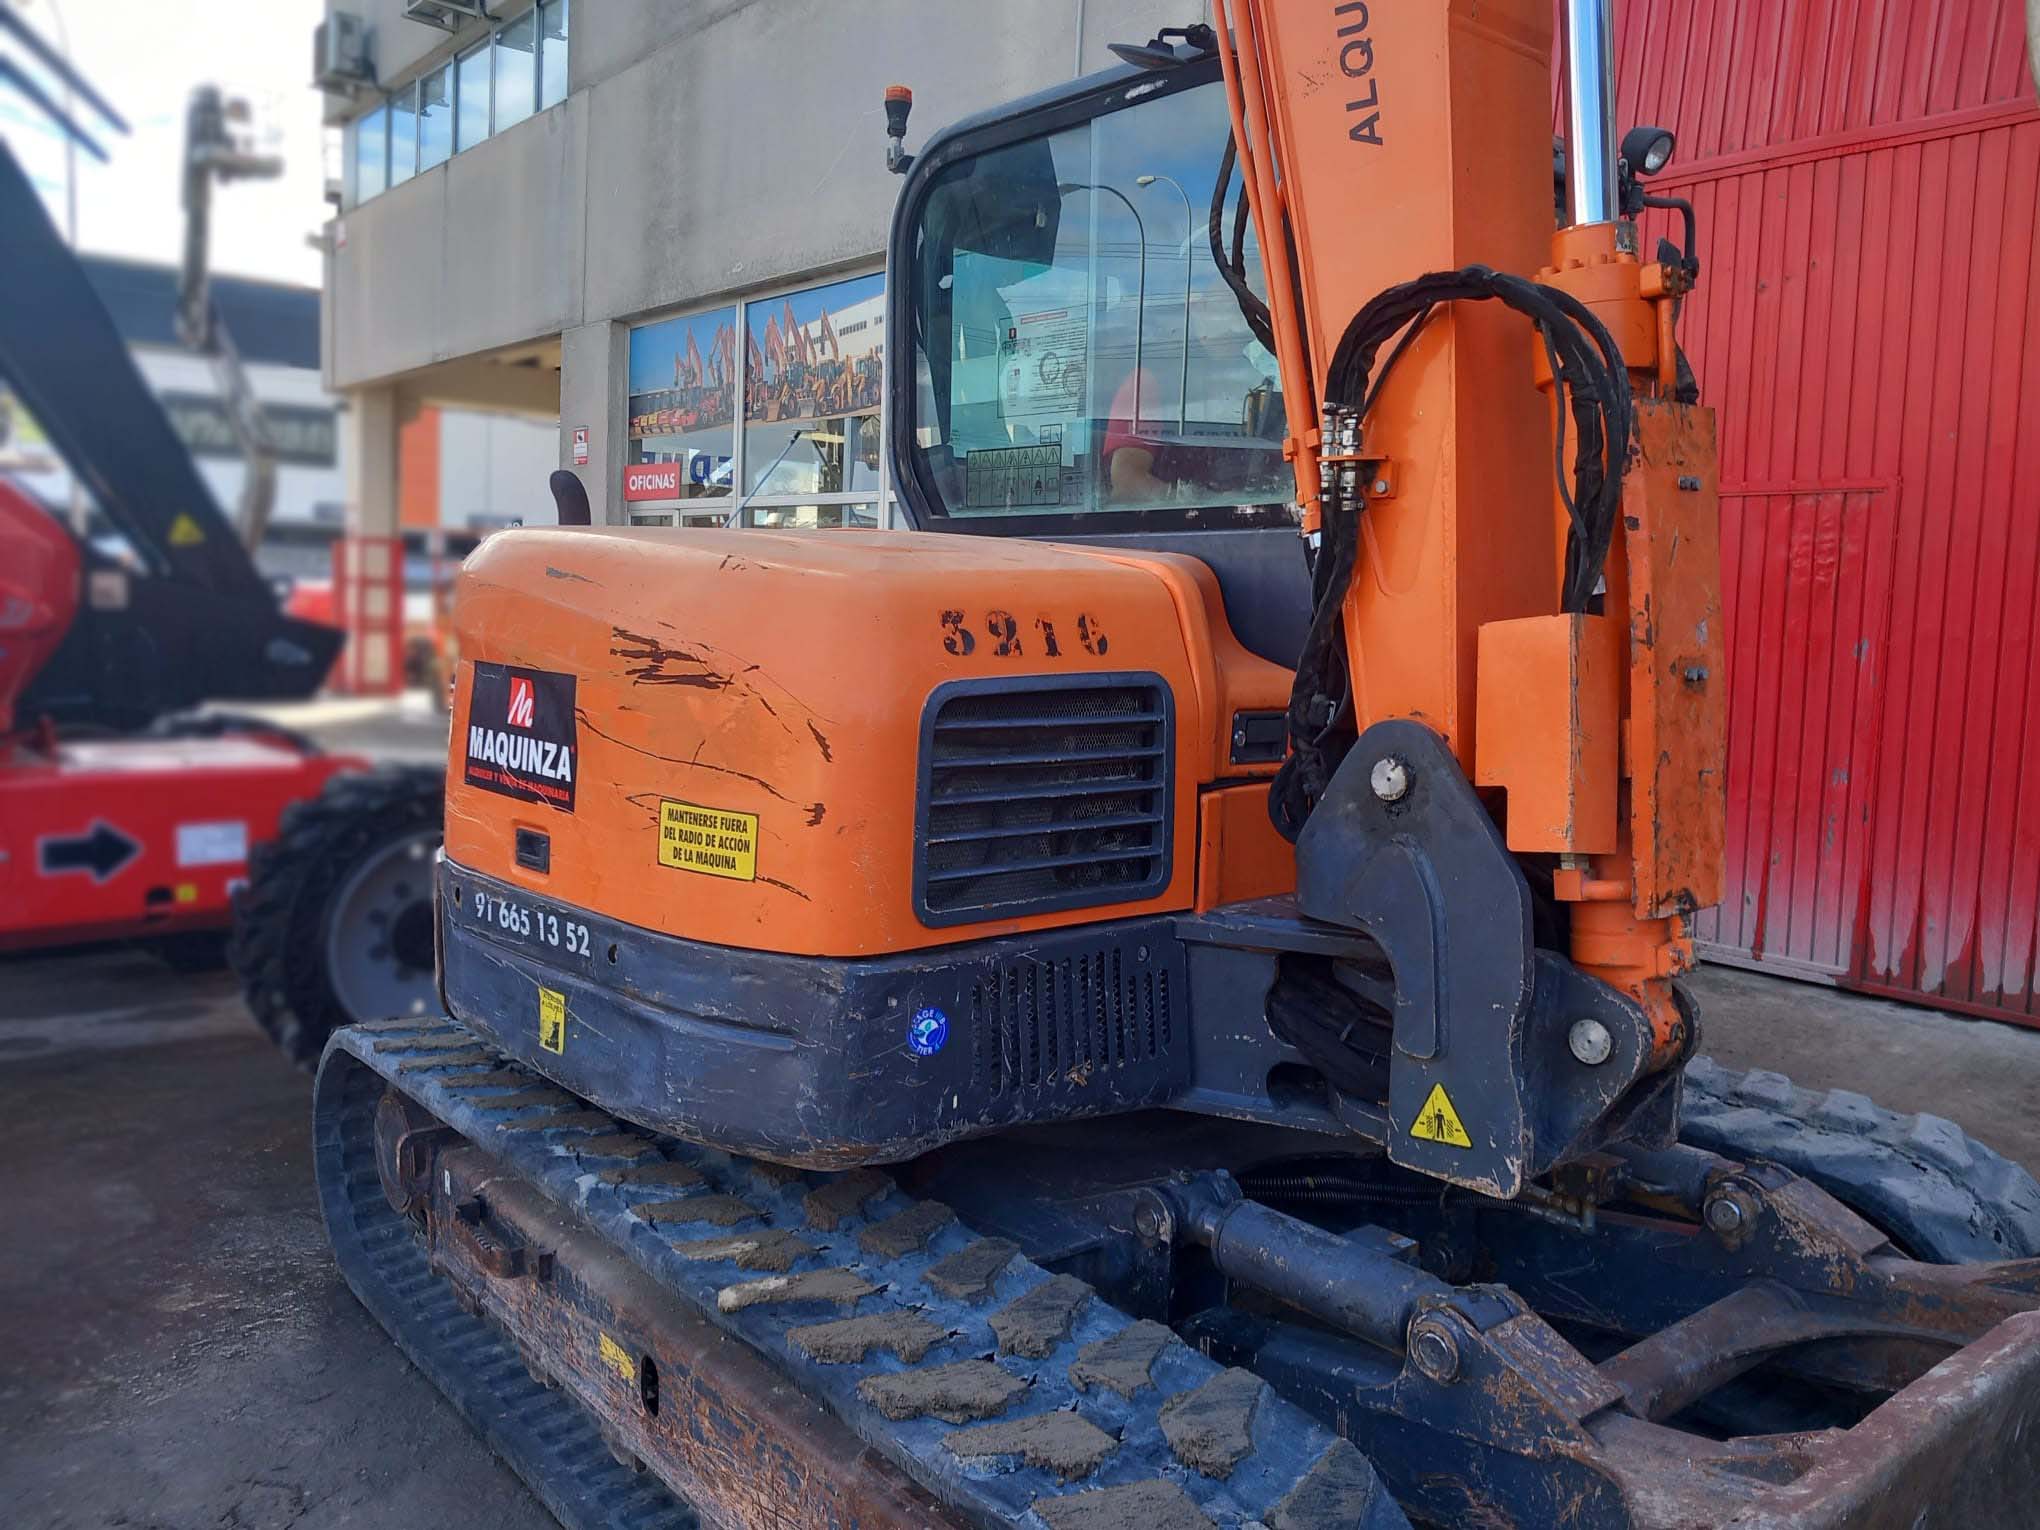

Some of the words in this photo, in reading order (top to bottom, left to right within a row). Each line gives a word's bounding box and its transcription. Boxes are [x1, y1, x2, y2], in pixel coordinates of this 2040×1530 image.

[1334, 1, 1384, 146] ALQU
[629, 472, 676, 491] OFICINAS
[469, 725, 572, 783] MAQUINZA
[667, 807, 718, 829] MANTENERSE
[720, 816, 748, 834] FUERA
[663, 825, 677, 841] DEL
[678, 828, 703, 846] RADIO
[705, 833, 716, 848] DE
[718, 835, 750, 853] ACCIÓN
[673, 846, 682, 860] DE
[684, 848, 694, 863] LA
[695, 849, 737, 871] MÁQUINA
[475, 892, 493, 922] 91
[499, 901, 530, 936] 665
[537, 912, 560, 947] 13
[566, 922, 591, 957] 52
